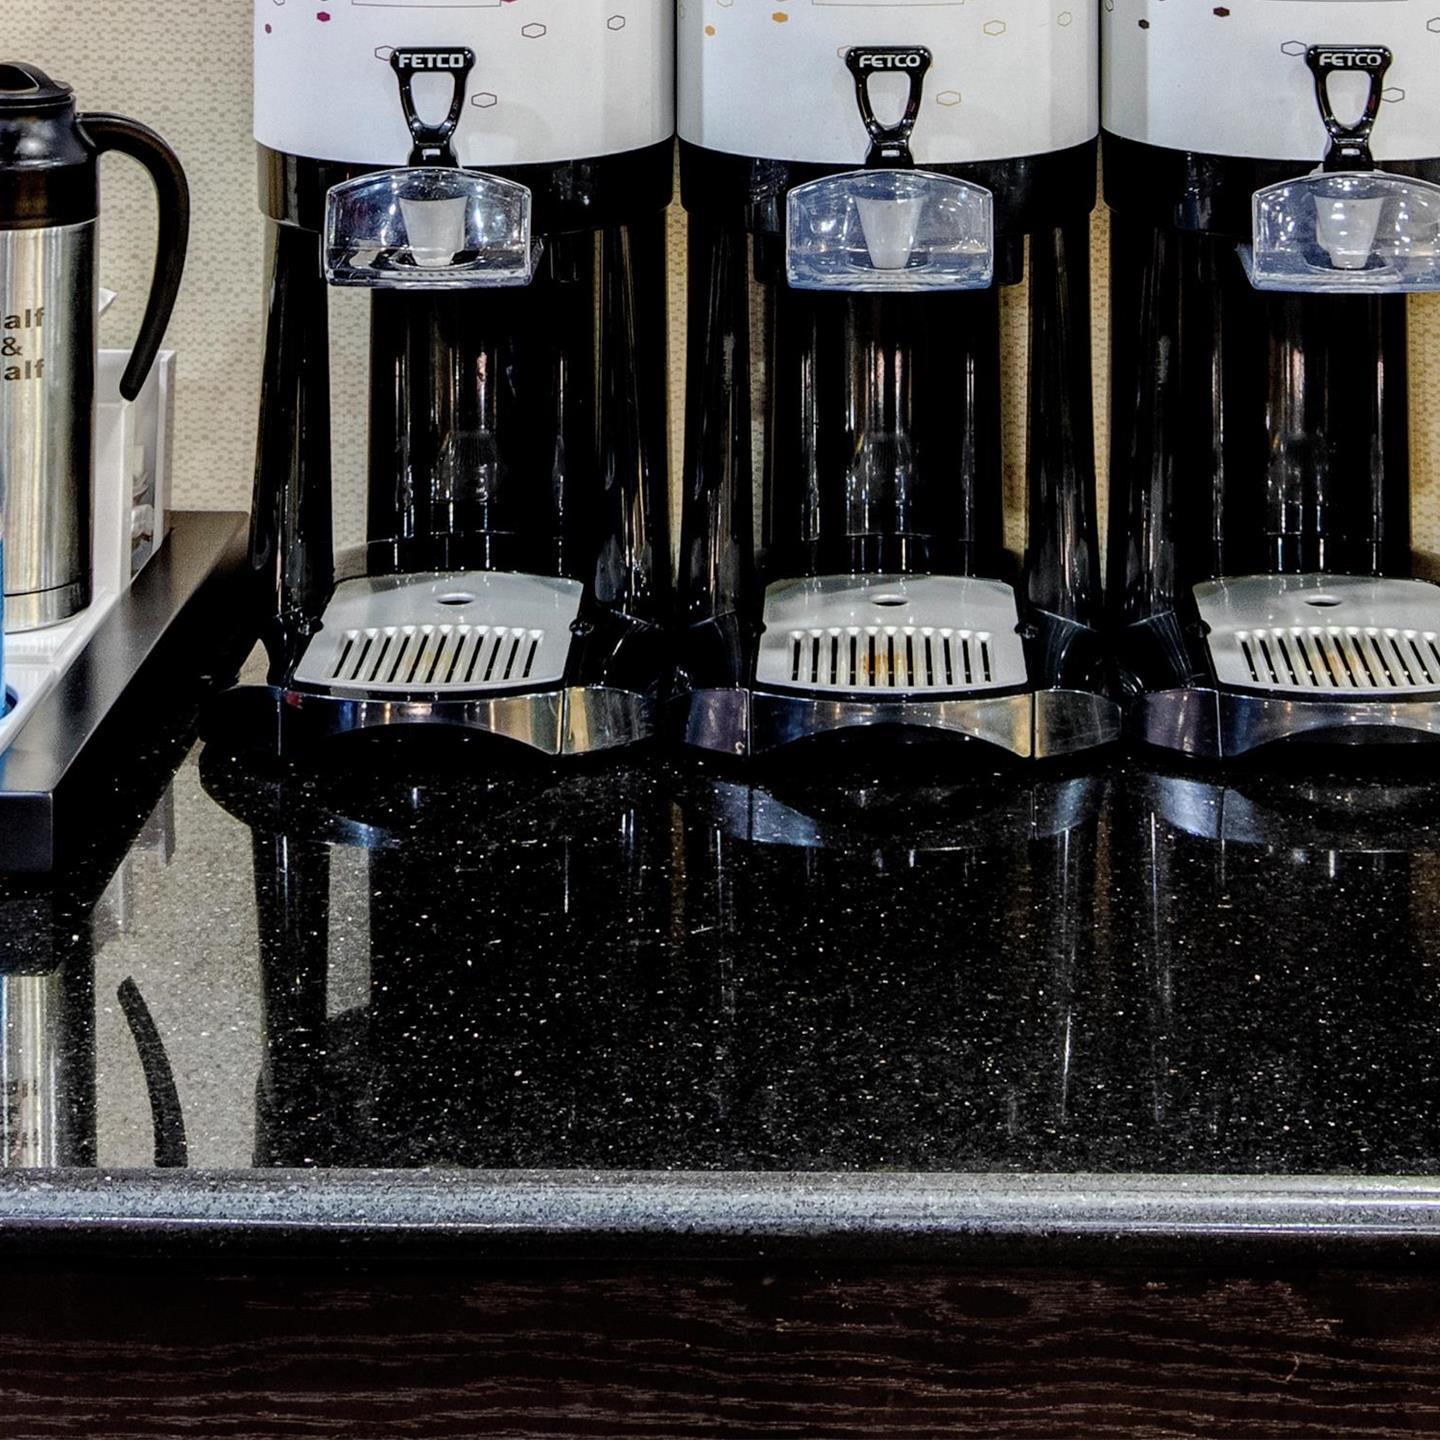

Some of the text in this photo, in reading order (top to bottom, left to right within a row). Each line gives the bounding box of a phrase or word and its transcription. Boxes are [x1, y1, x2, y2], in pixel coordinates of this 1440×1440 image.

[398, 53, 464, 68] FETCO
[859, 54, 921, 68] FETCO
[1319, 53, 1382, 67] FETCO
[1, 336, 23, 357] &
